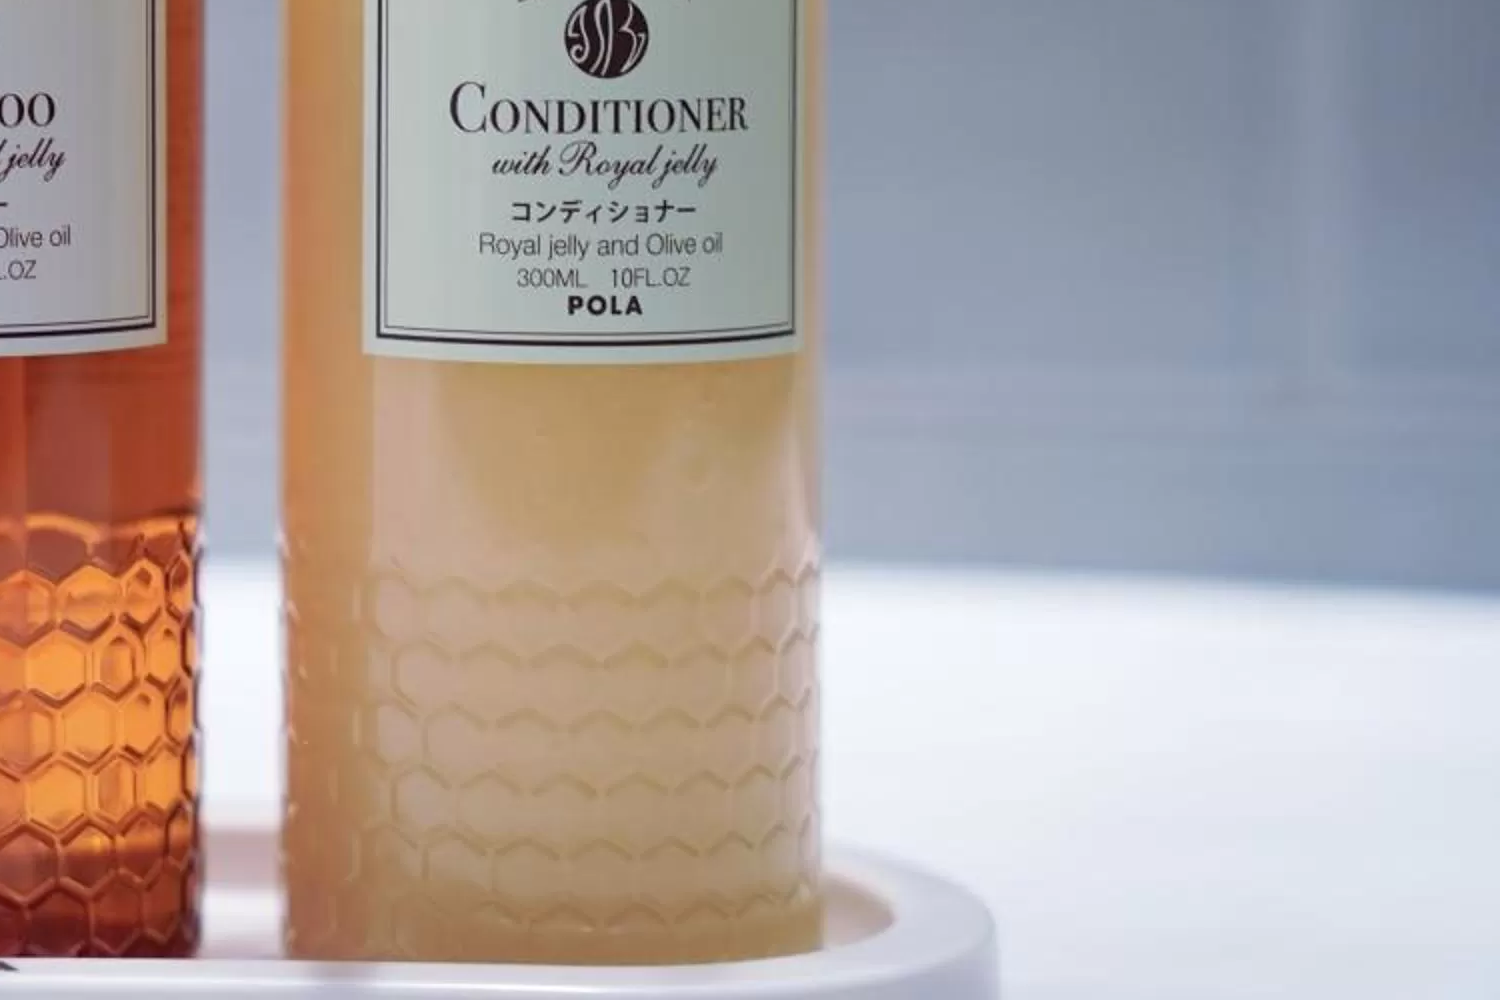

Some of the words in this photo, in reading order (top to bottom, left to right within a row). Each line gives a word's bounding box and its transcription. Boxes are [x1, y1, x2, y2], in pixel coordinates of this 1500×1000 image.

[492, 145, 553, 175] with
[558, 140, 658, 190] Royal
[652, 143, 717, 189] jelly
[511, 199, 696, 224] コンディショナー
[49, 225, 70, 247] oil
[479, 232, 541, 260] Royal
[548, 234, 589, 260] jelly
[597, 235, 638, 256] and
[646, 234, 697, 255] Olive
[702, 231, 722, 253] oil
[517, 268, 588, 288] 300ML
[611, 267, 691, 288] 10FL.OZ
[568, 295, 642, 316] POLA
